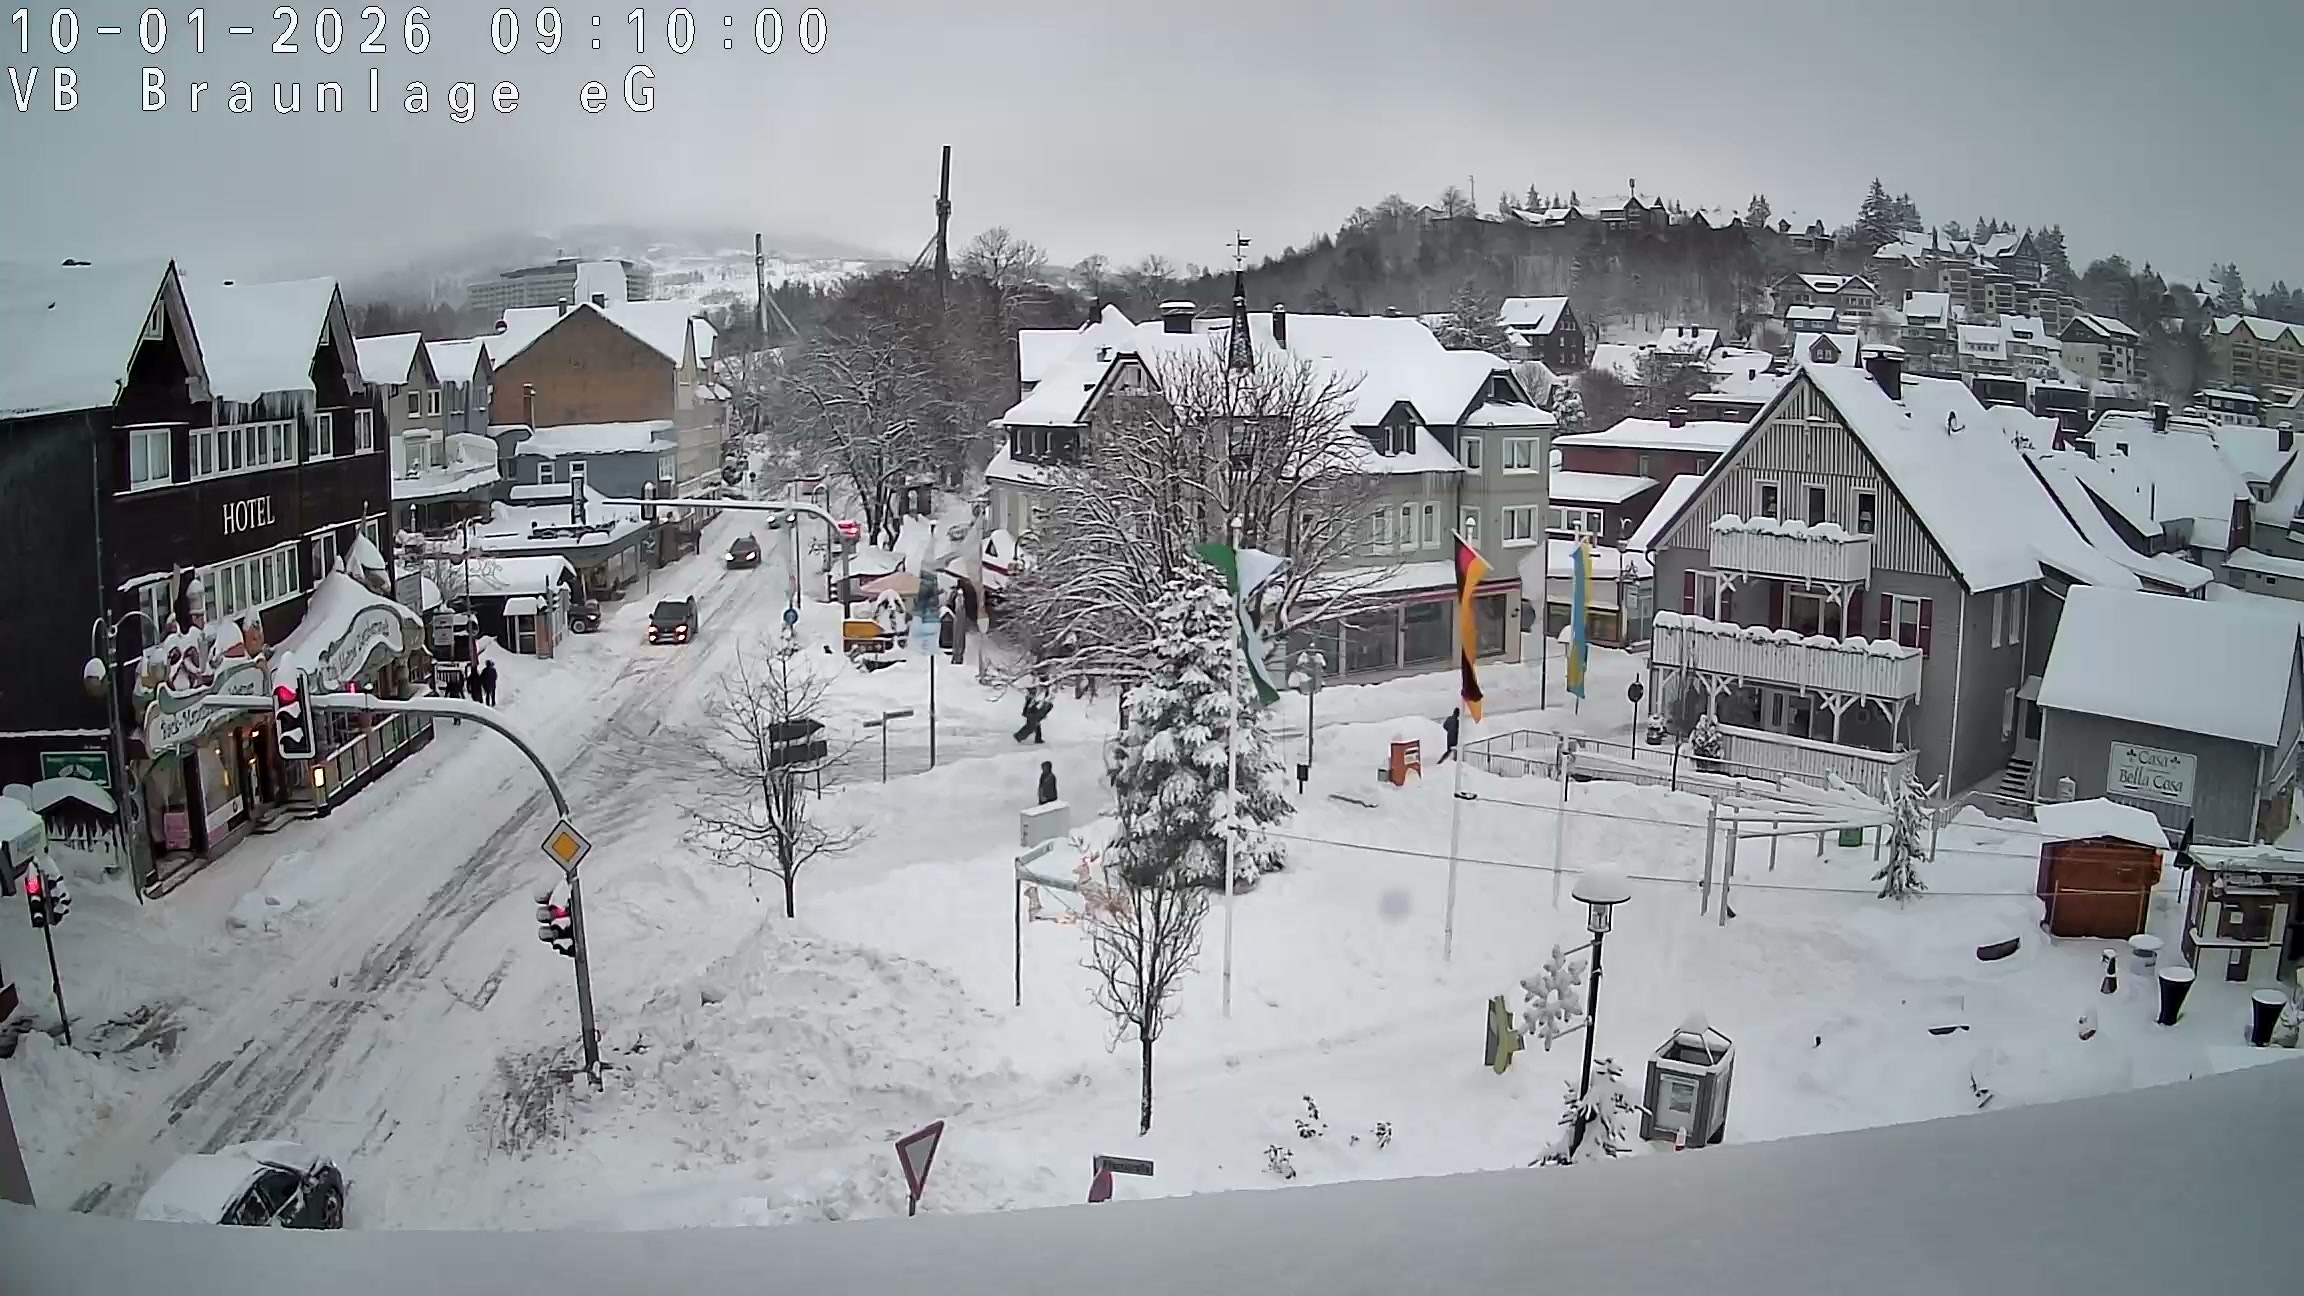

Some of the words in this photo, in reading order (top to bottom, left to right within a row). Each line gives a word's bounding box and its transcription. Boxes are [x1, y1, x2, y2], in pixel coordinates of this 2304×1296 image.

[222, 495, 276, 535] HOTEL
[2138, 751, 2168, 767] Casa
[2119, 767, 2149, 786] Bella
[2153, 776, 2183, 792] Casa
